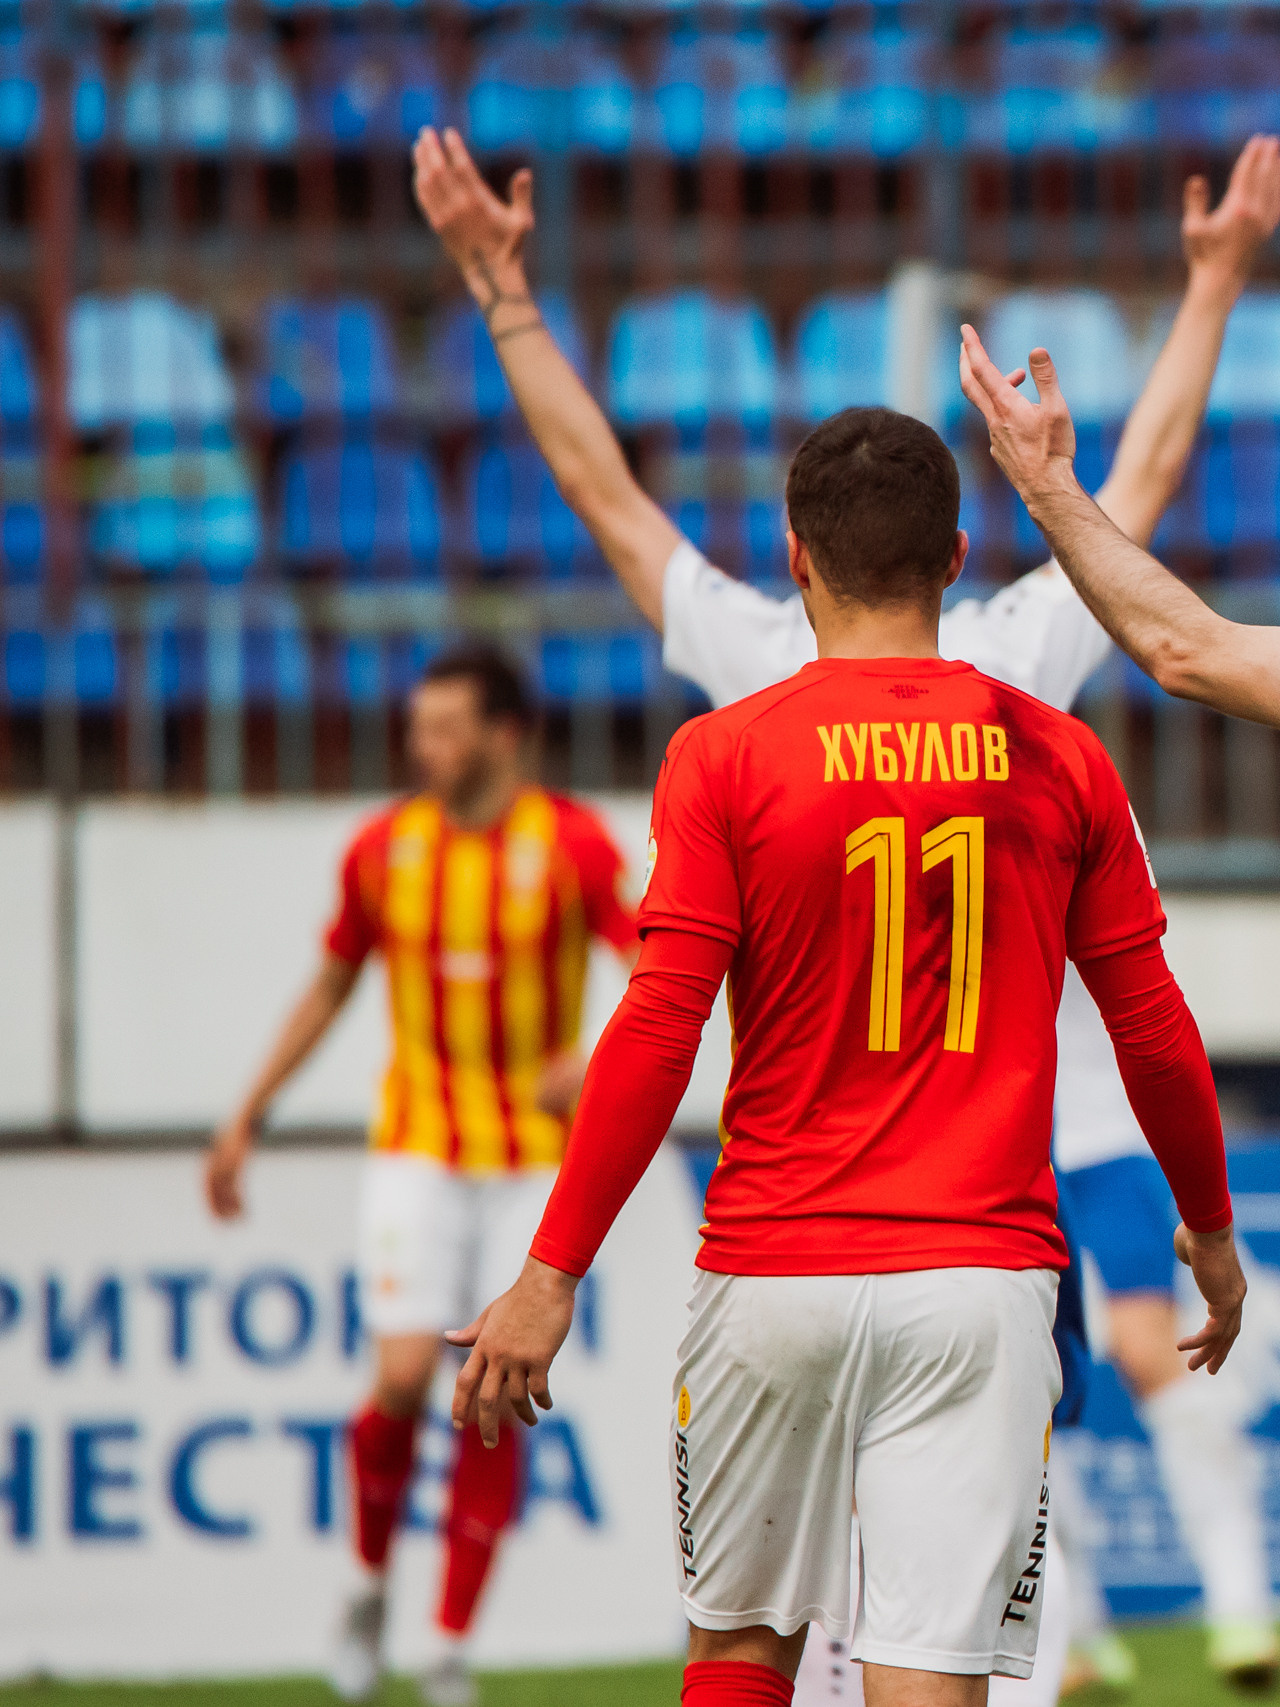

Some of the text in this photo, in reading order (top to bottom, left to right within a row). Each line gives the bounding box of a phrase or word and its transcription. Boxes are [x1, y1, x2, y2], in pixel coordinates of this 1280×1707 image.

[817, 722, 1009, 783] ХУБУЛОВ
[845, 816, 985, 1054] 11
[675, 1430, 698, 1580] TENNISI
